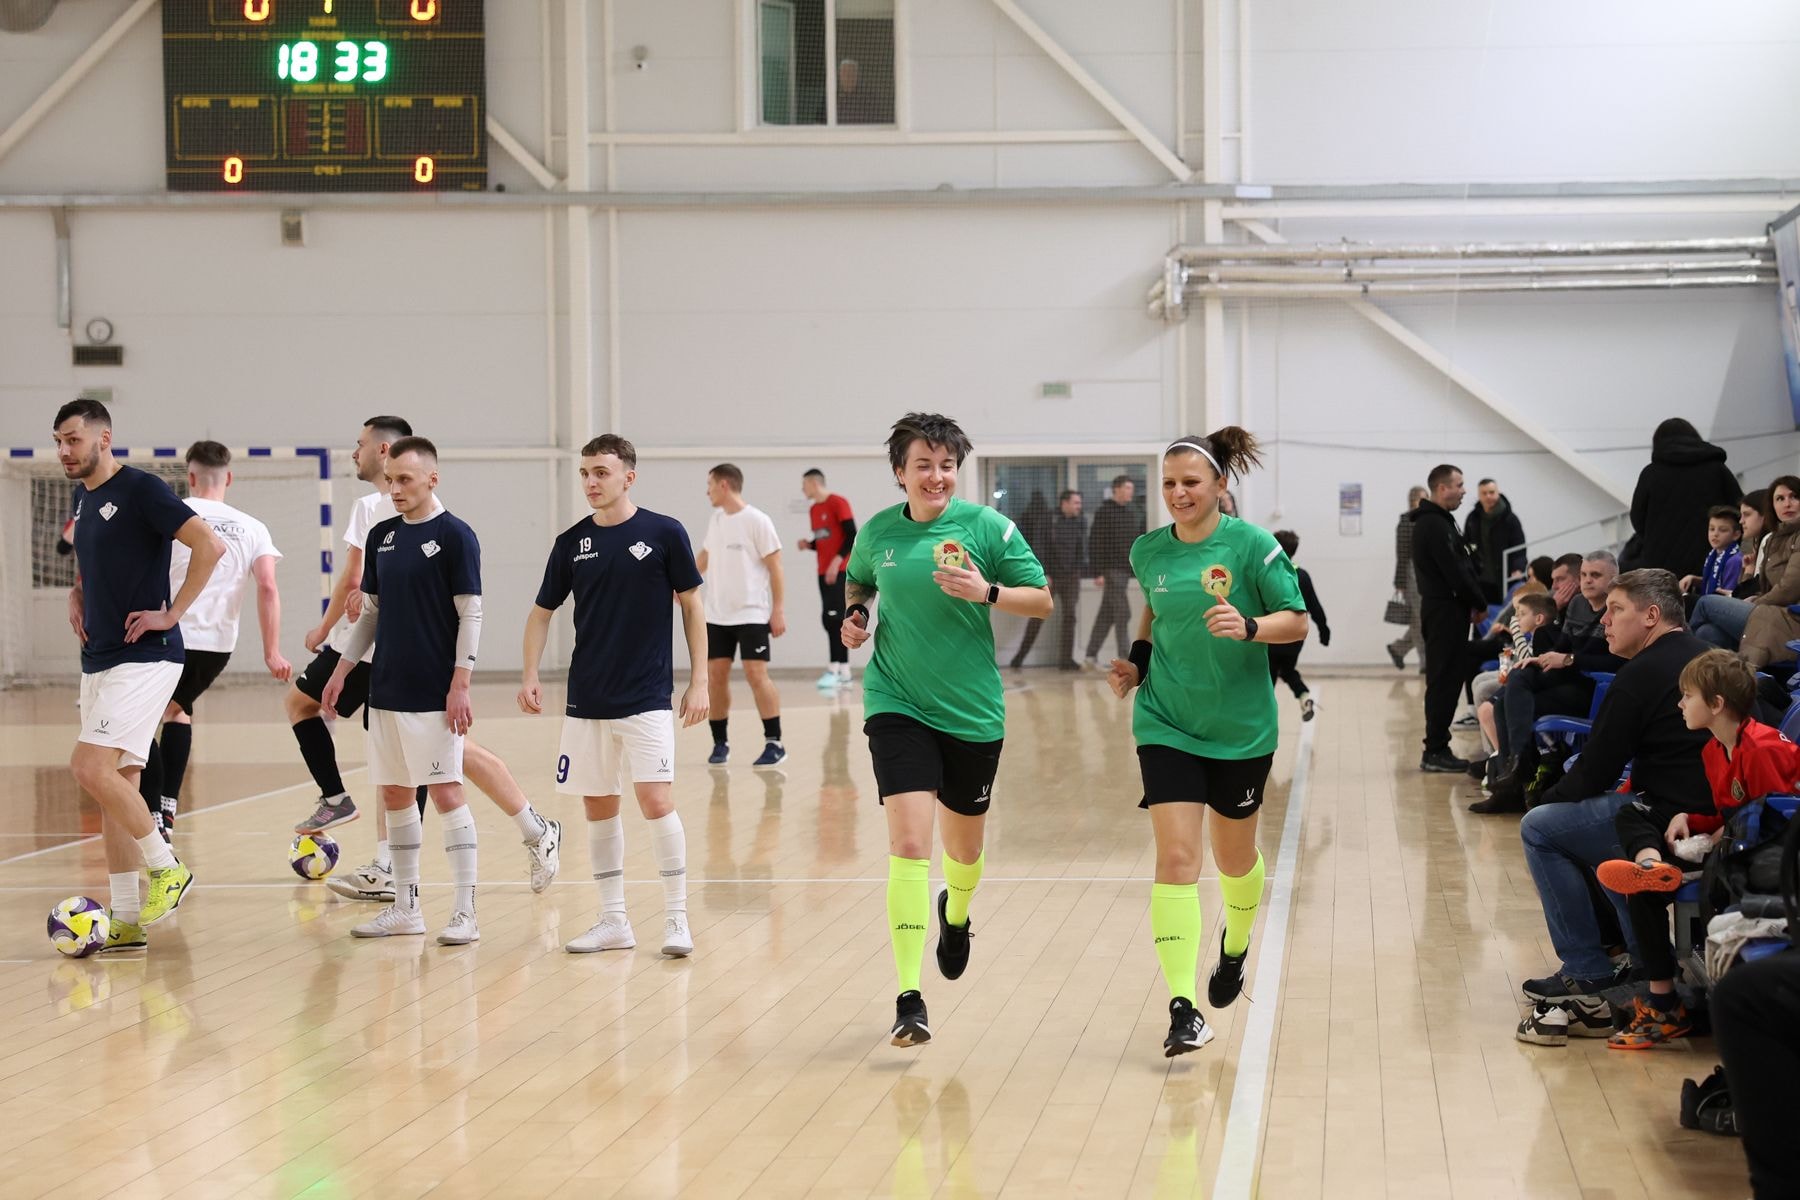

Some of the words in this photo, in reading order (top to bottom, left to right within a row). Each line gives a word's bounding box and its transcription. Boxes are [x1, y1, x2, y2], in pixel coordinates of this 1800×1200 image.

[278, 41, 318, 82] 18
[334, 41, 387, 82] 33
[224, 156, 243, 183] 0
[414, 156, 434, 183] 0
[383, 530, 396, 545] 18
[579, 537, 592, 553] 19
[573, 552, 599, 562] uhlsport
[556, 754, 570, 784] 9
